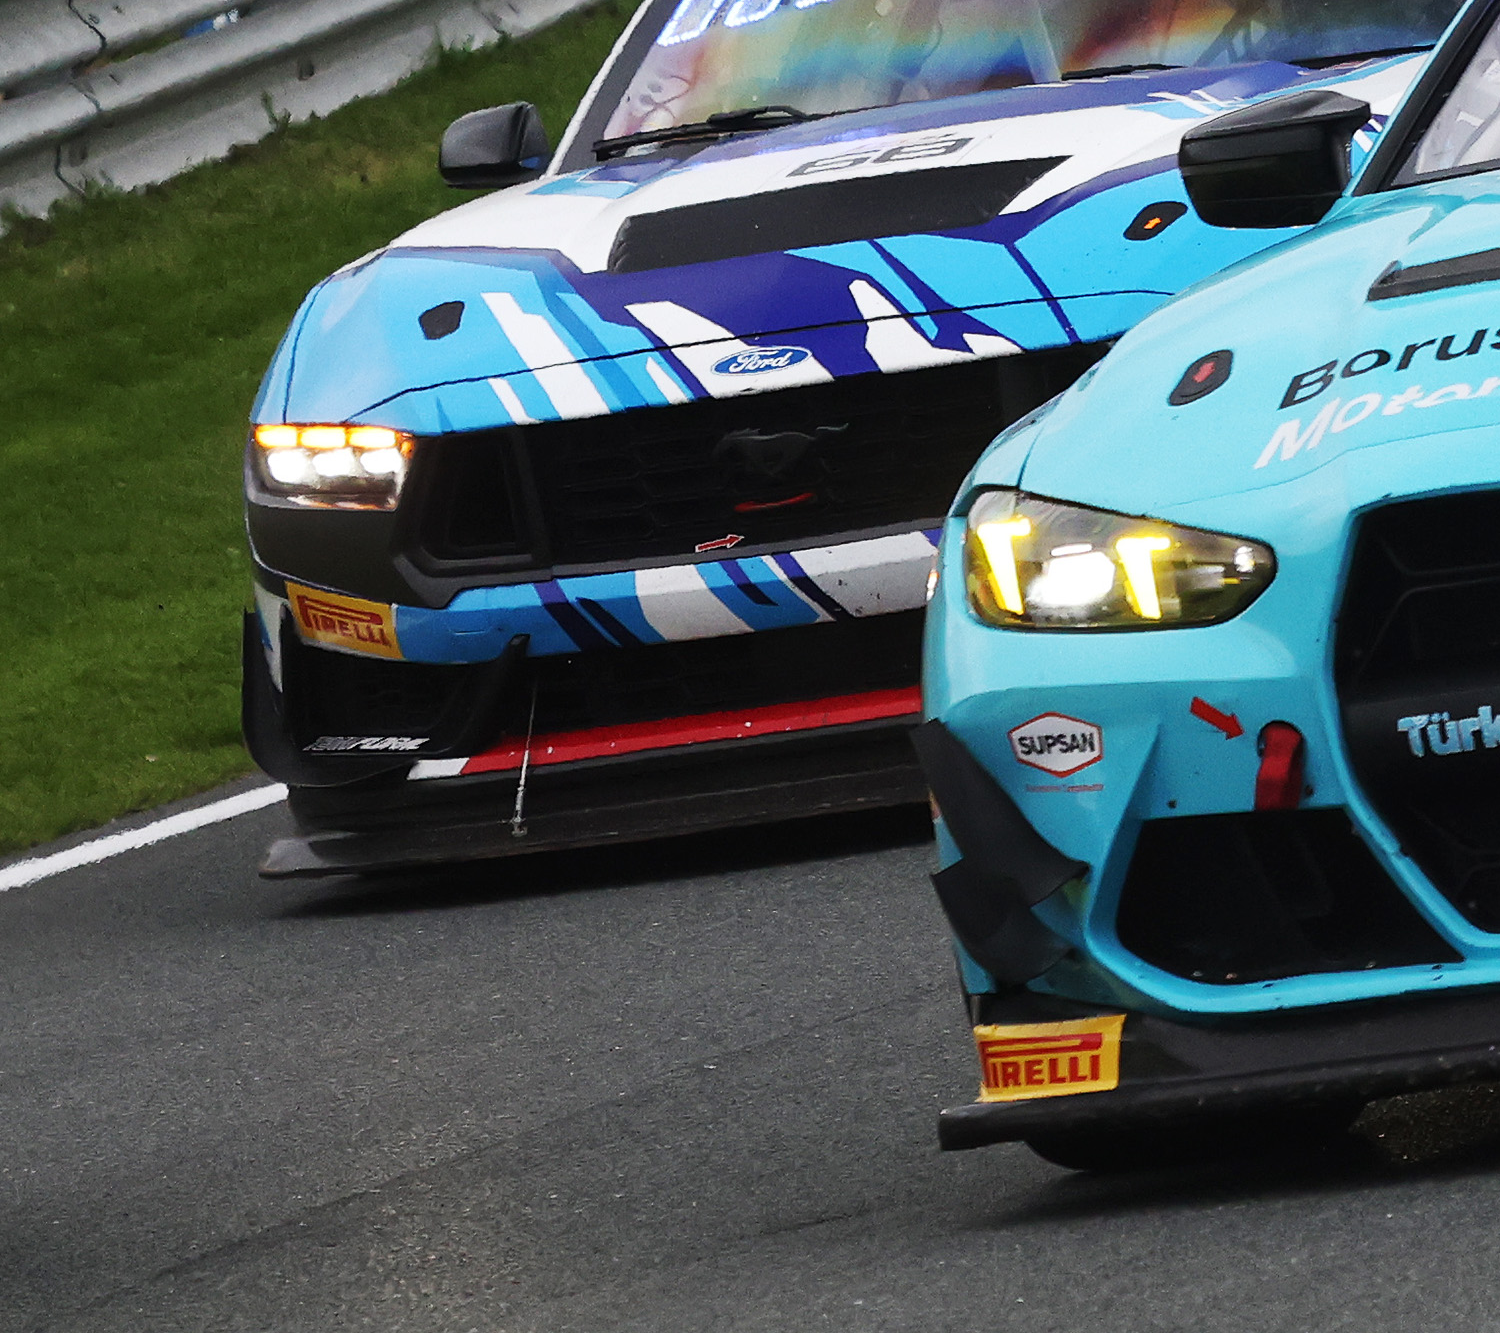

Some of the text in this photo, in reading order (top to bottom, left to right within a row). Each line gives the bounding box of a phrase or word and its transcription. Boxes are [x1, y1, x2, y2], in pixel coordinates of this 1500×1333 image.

[729, 350, 794, 373] Ford
[296, 595, 392, 648] PIRELLI
[1017, 732, 1096, 756] SUPSAN
[978, 1032, 1104, 1090] PIRELLI
